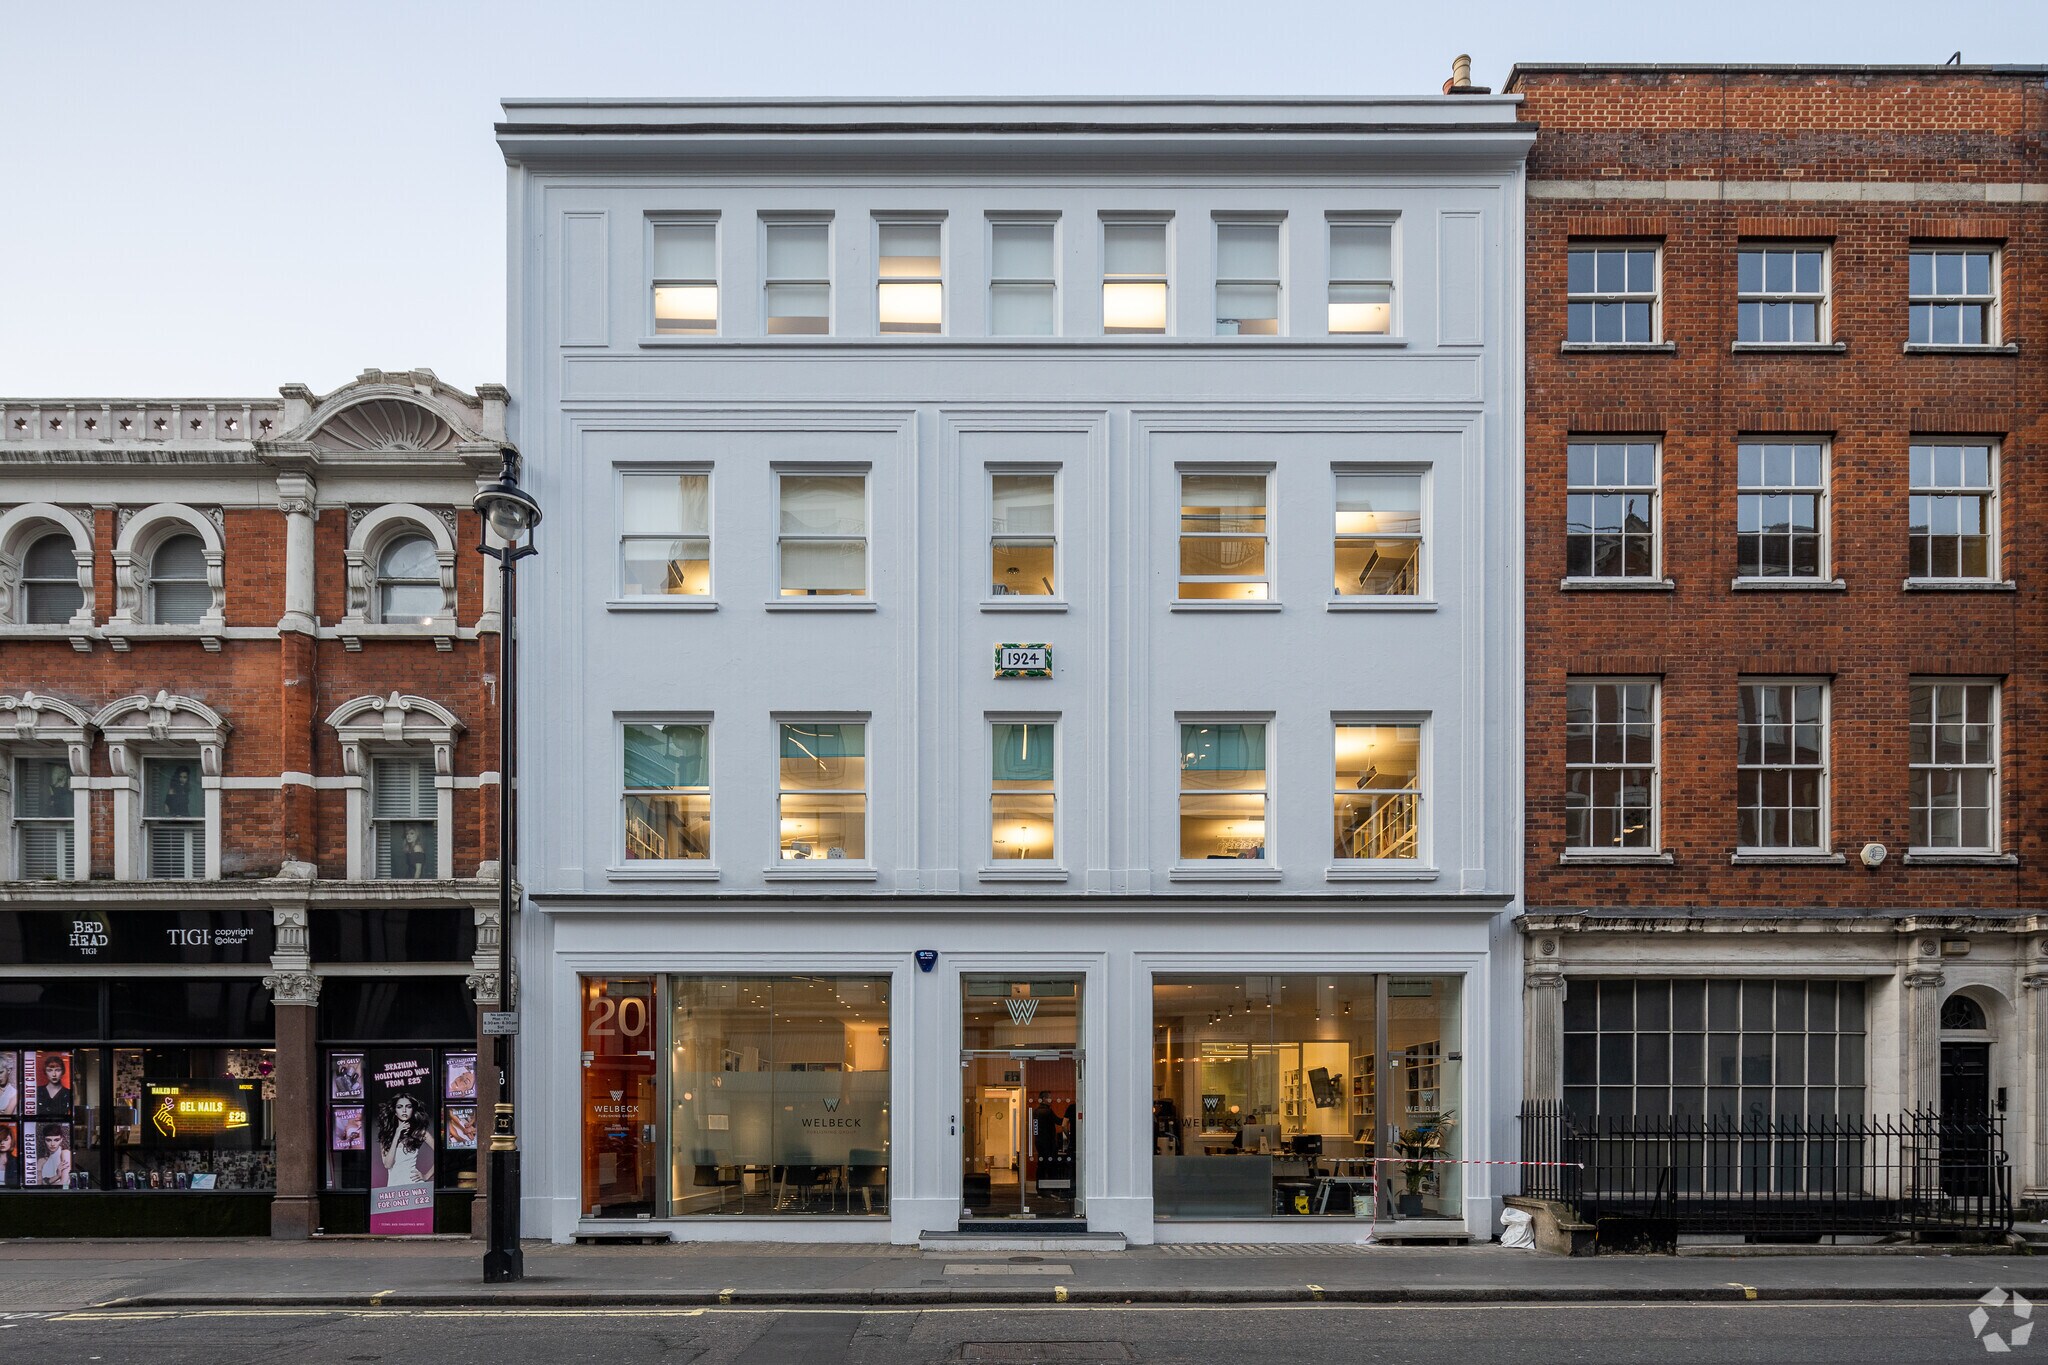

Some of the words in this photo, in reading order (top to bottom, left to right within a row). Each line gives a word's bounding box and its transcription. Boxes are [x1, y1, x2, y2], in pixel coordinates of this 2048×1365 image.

[1008, 652, 1040, 666] 1924
[72, 920, 104, 934] BED
[69, 933, 109, 947] HEAD
[166, 929, 209, 946] TIGI
[214, 928, 254, 938] copyright
[80, 947, 97, 955] TIGI
[587, 996, 647, 1037] 20
[25, 1059, 36, 1082] CHILLI
[384, 1060, 418, 1071] BRAZILIAN
[374, 1069, 413, 1081] HOLLYWOOD
[414, 1067, 430, 1076] WAX
[385, 1078, 405, 1088] FROM
[25, 1084, 36, 1099] HOT
[25, 1100, 36, 1115] RED
[180, 1101, 196, 1112] GEL
[197, 1101, 223, 1112] NAILS
[594, 1105, 639, 1113] WELBECK
[801, 1118, 862, 1128] WELBECK
[1181, 1117, 1242, 1127] WELBECK
[25, 1132, 36, 1159] PEPPER
[26, 1161, 37, 1185] BLACK
[379, 1191, 396, 1200] HALF
[398, 1190, 410, 1198] LEG
[411, 1188, 427, 1196] WAX
[377, 1201, 391, 1209] FOR
[392, 1199, 410, 1207] ONLY
